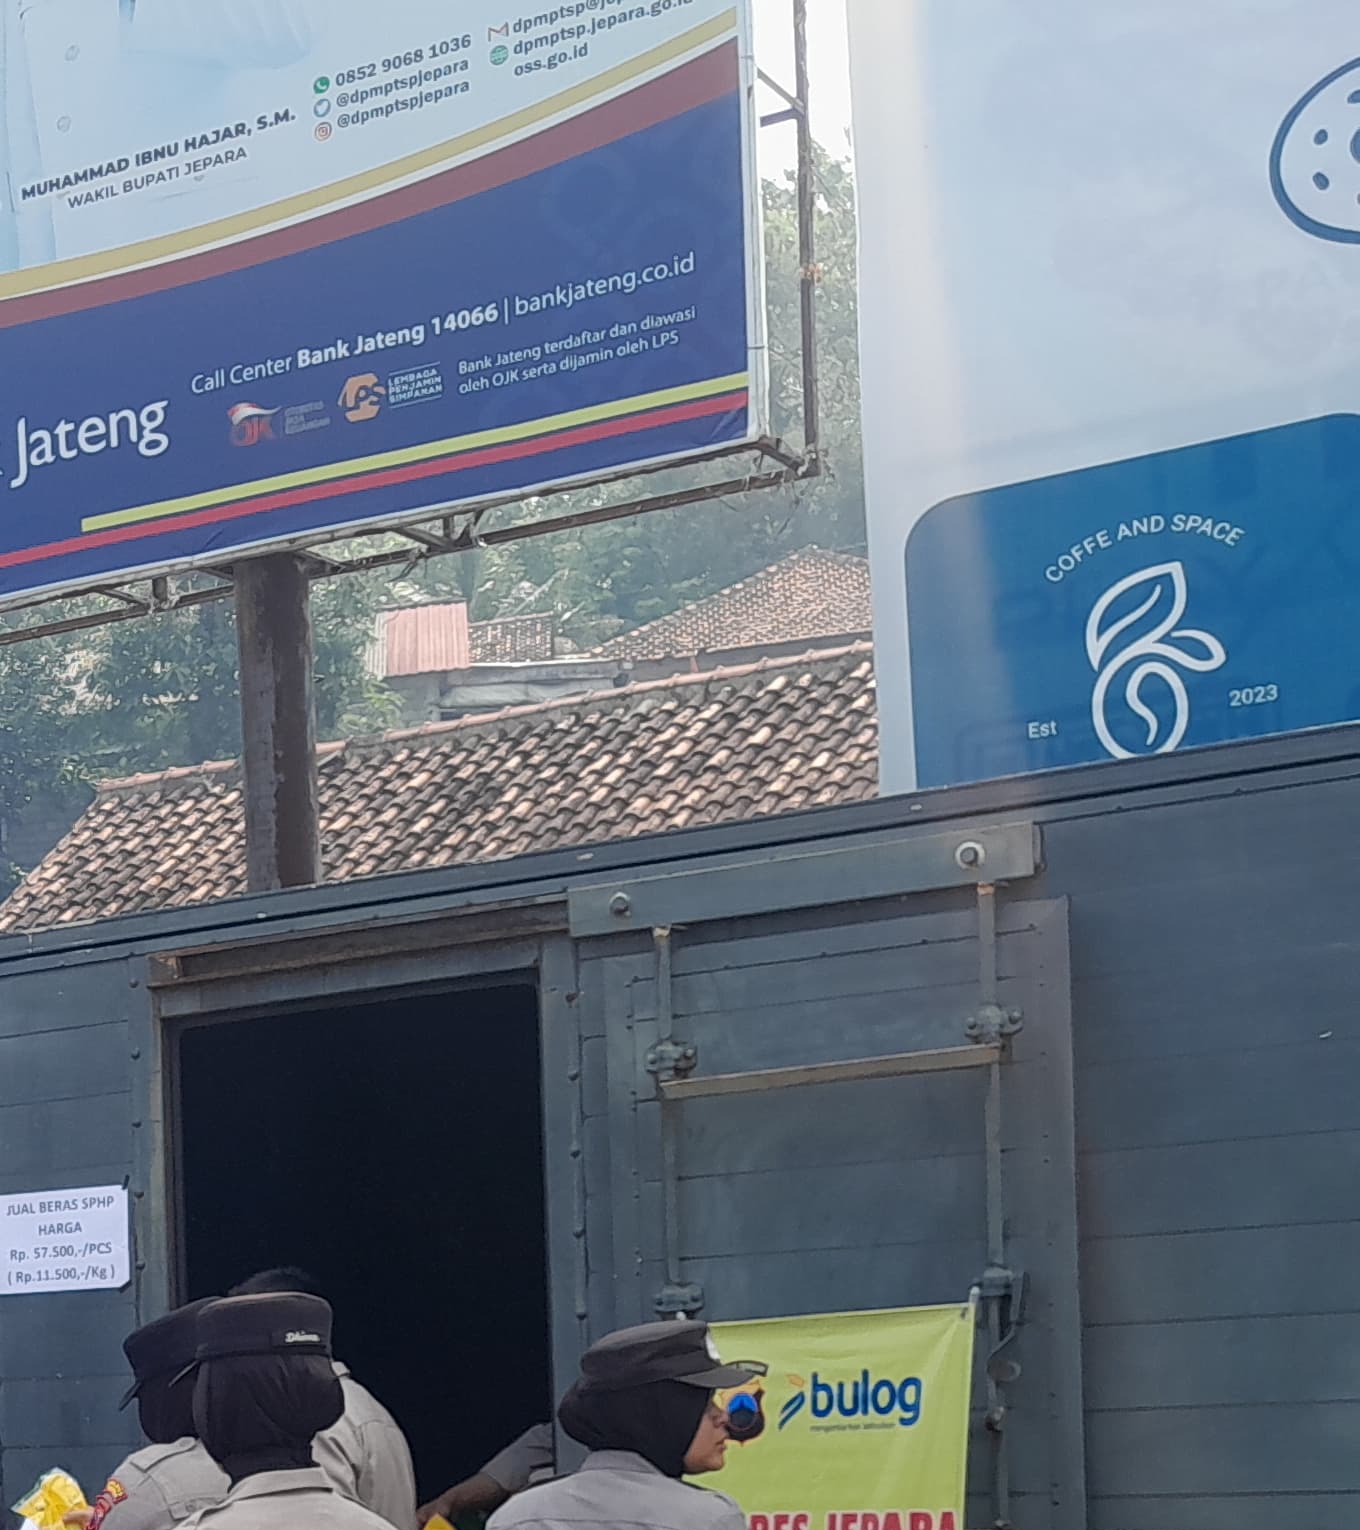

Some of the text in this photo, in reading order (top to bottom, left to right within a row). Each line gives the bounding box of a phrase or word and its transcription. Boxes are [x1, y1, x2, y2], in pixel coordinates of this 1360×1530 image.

[513, 0, 622, 33] dpmptsp@j
[513, 0, 693, 55] dpmptsp.jepara.go.
[335, 34, 472, 87] 0852 9068 1036
[336, 58, 469, 108] @dpmptspjepara
[514, 43, 588, 76] oss.go.id
[337, 79, 470, 130] @dpmptspjepara
[21, 108, 296, 201] MUHAMMAD IBNU HAJAR, S.M.
[68, 146, 248, 209] WAKIL BUPATI JEPARA
[191, 373, 225, 395] Call
[230, 356, 292, 386] Center
[297, 339, 350, 369] Bank
[354, 324, 425, 357] Jateng
[431, 303, 499, 334] 14066
[515, 252, 695, 319] bankjateng.co.id
[459, 306, 696, 375] Bank Jateng terdaftar dan diawasi
[459, 330, 679, 395] oleh OJK serta dijamin oleh LPS
[10, 400, 169, 488] Jateng
[1045, 514, 1245, 582] COFFE AND SPACE
[1229, 684, 1278, 706] 2023
[1027, 720, 1057, 739] Est
[6, 1196, 114, 1216] JUAL BERAS SPHP
[38, 1222, 82, 1236] HARGA
[10, 1242, 112, 1263] Rp. 57.500,-/PCS
[811, 1368, 922, 1426] bulog
